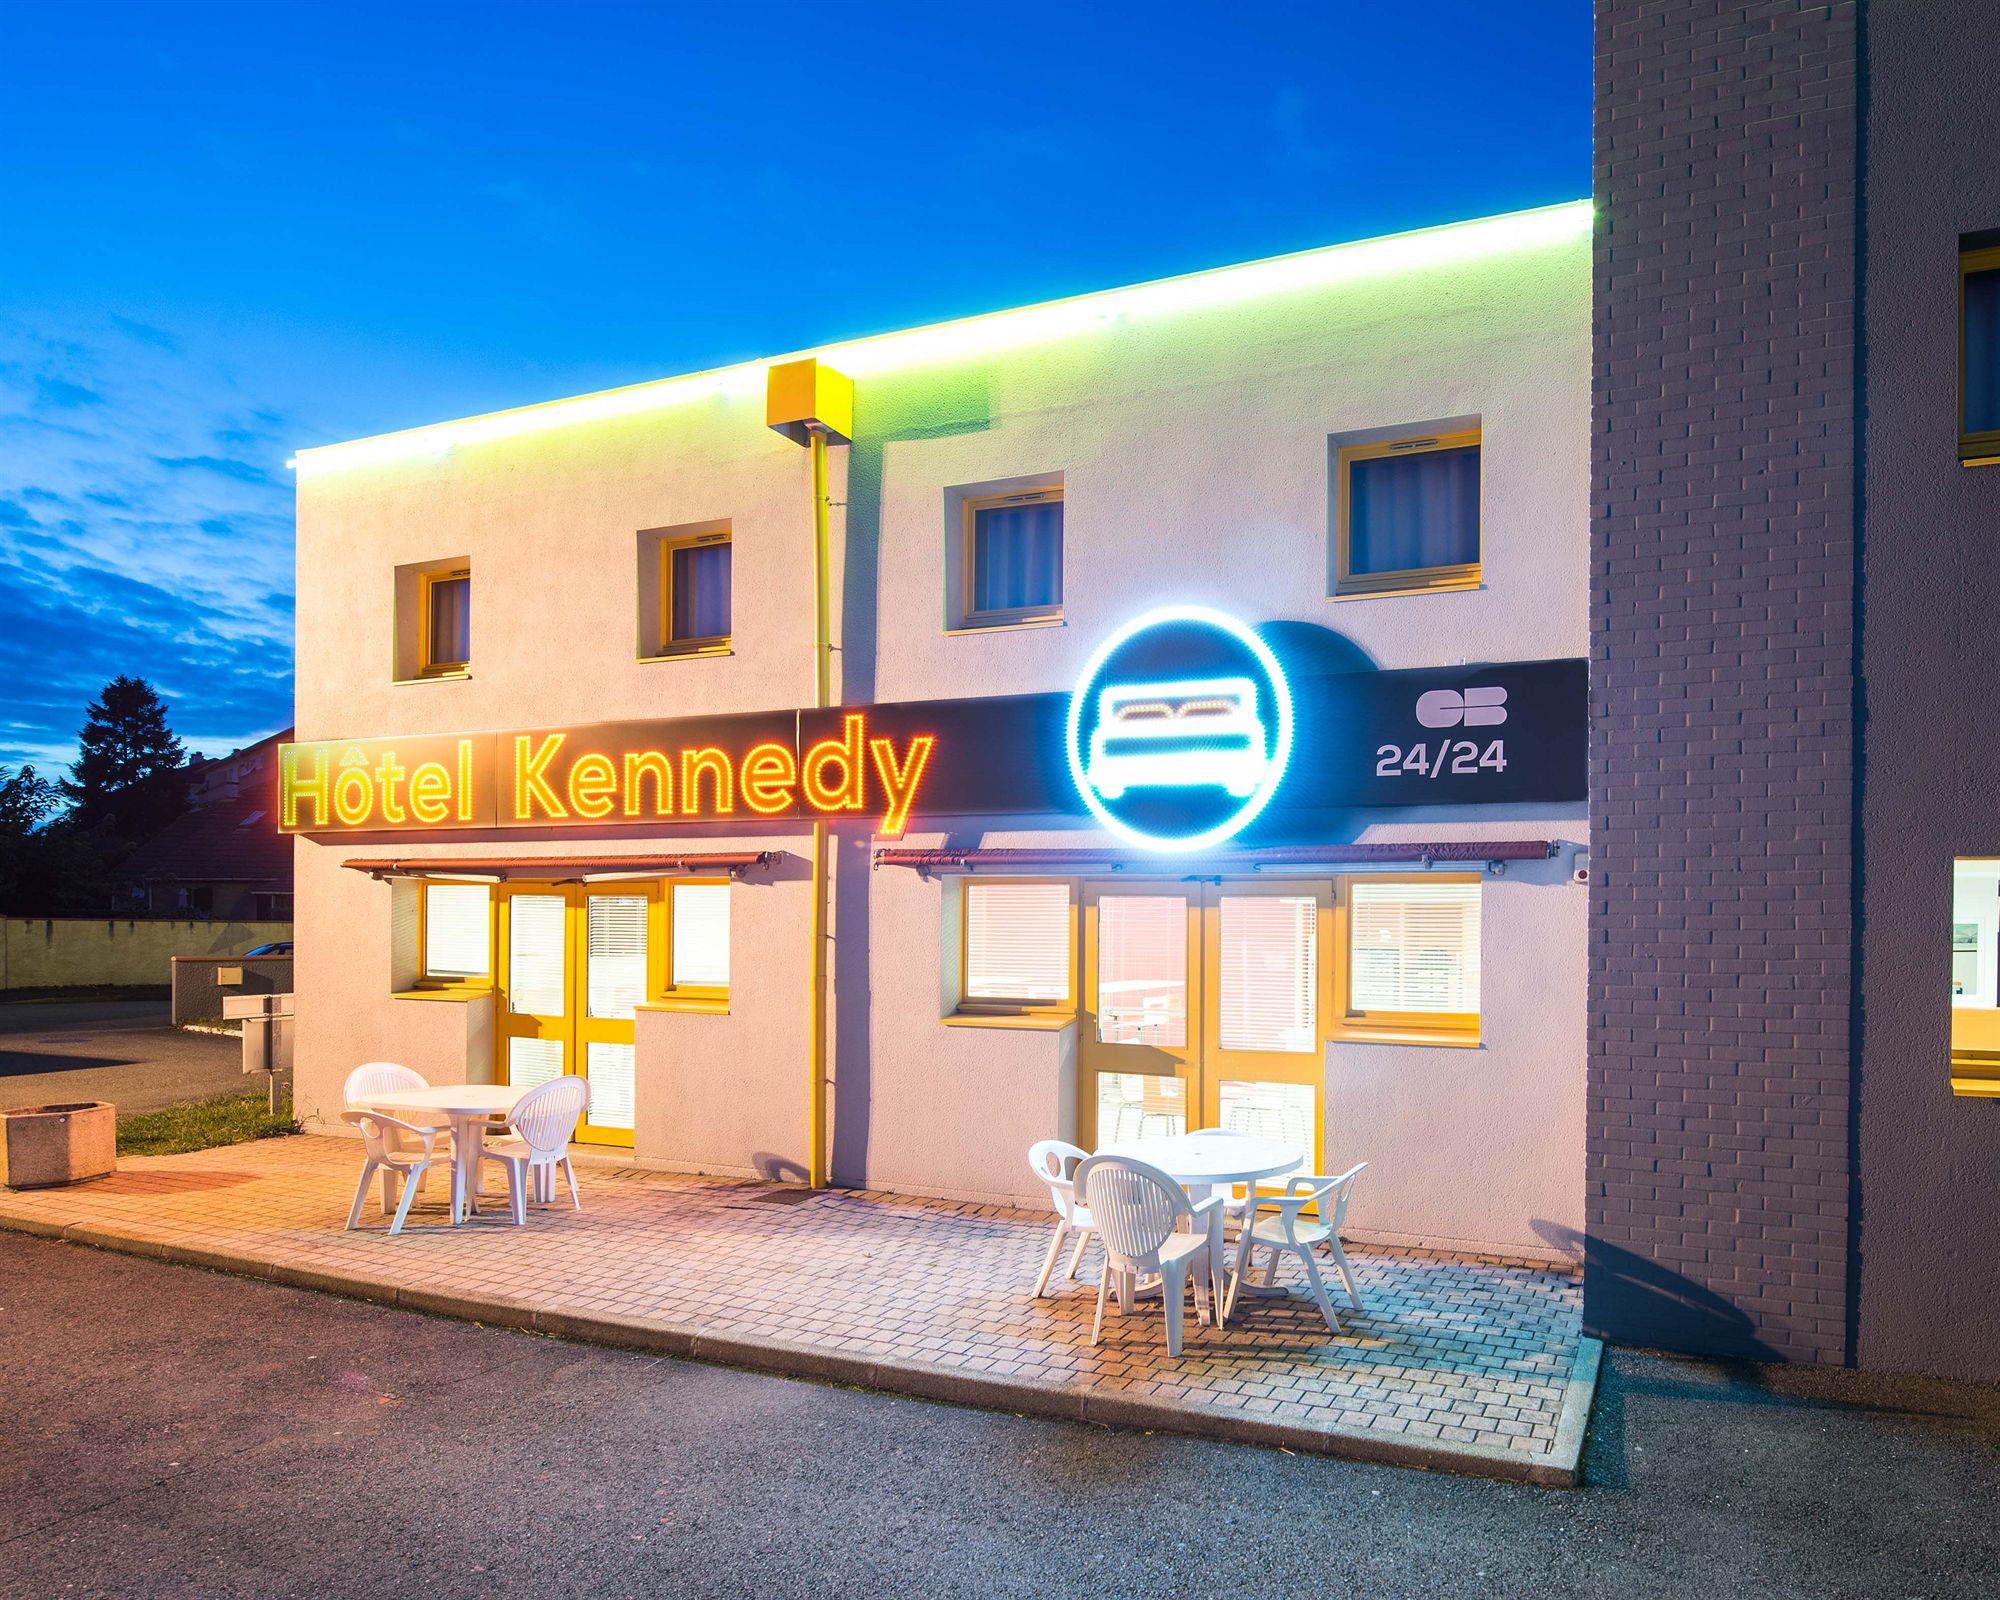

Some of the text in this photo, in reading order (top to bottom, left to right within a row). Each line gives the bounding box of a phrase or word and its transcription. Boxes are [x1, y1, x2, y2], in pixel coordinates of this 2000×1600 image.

[1415, 686, 1508, 729] CB
[282, 713, 935, 836] Hôtel Kennedy
[1376, 739, 1507, 778] 24/24
